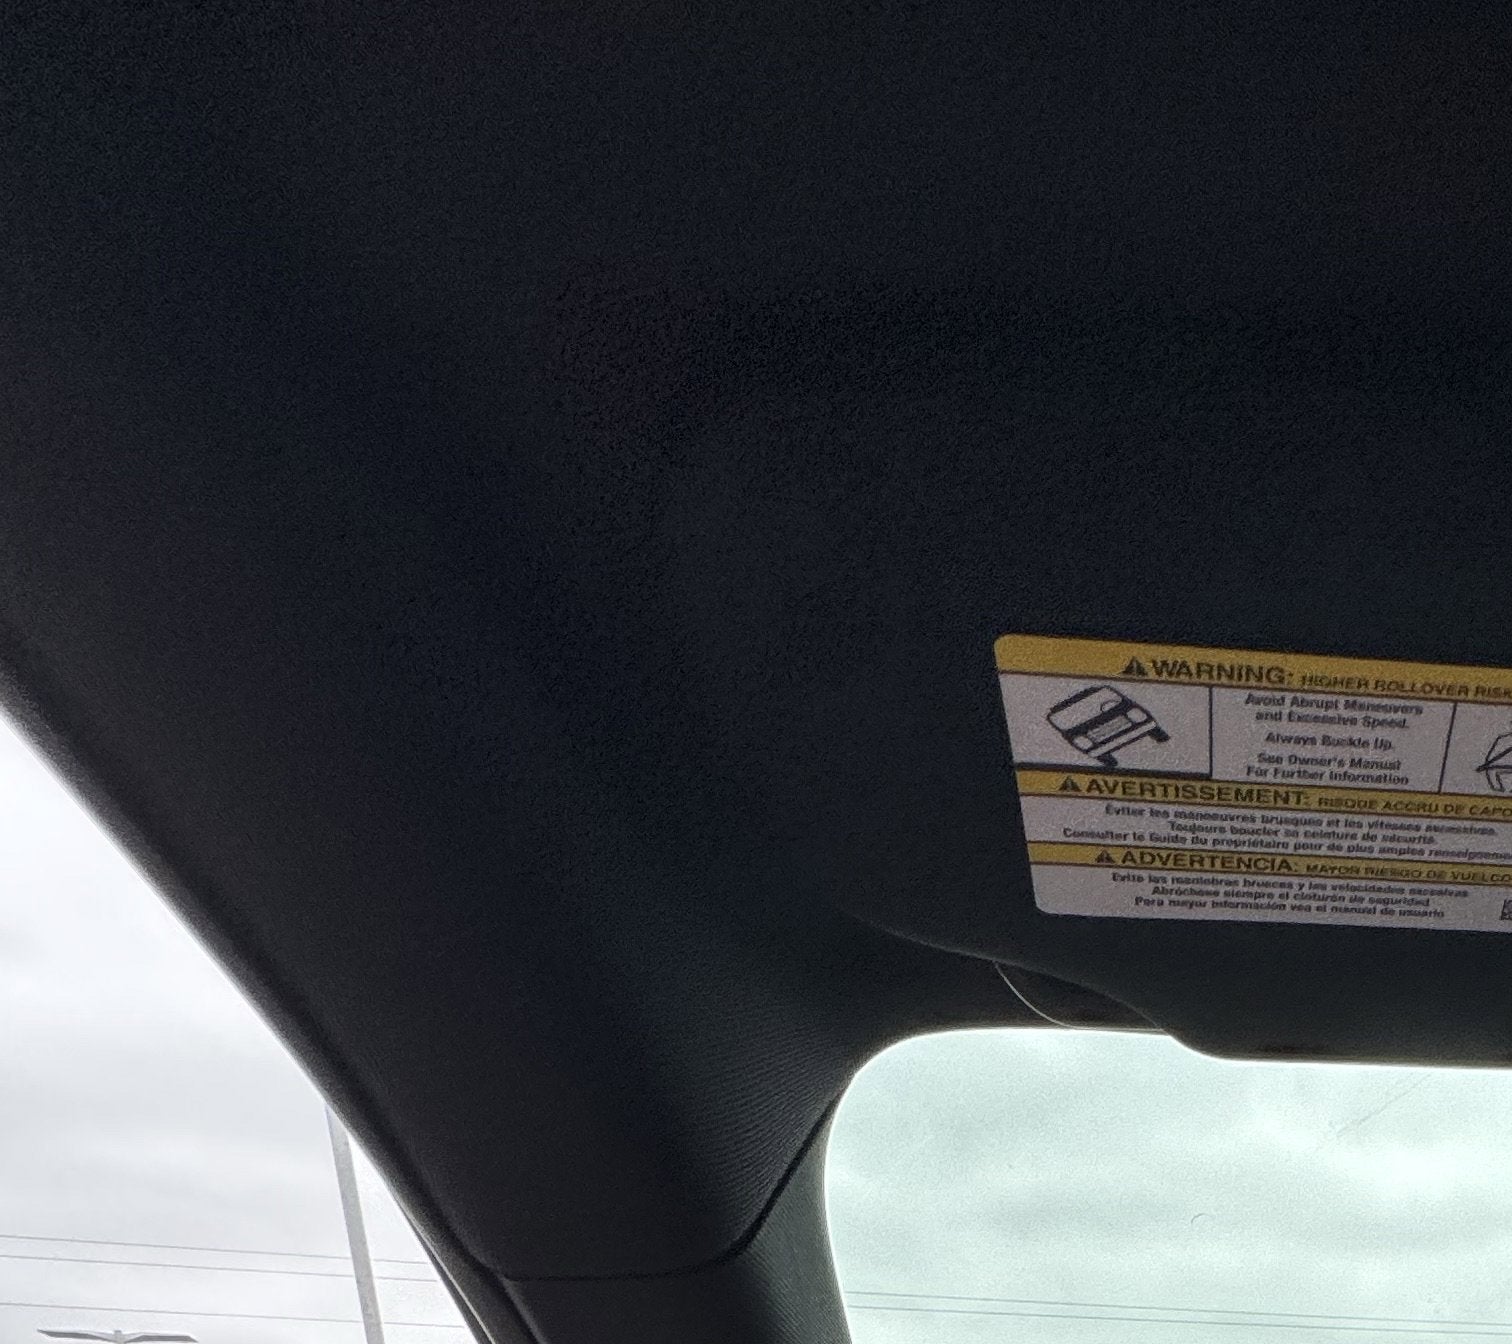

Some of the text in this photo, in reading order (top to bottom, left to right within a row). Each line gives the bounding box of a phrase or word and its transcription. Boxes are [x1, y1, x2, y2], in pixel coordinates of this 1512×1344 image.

[1150, 658, 1295, 686] WARNING:
[1373, 678, 1470, 697] ROLLOVER
[1085, 779, 1310, 807] AVERTISSEMENT:
[1119, 849, 1300, 871] ADVERTENCIA:
